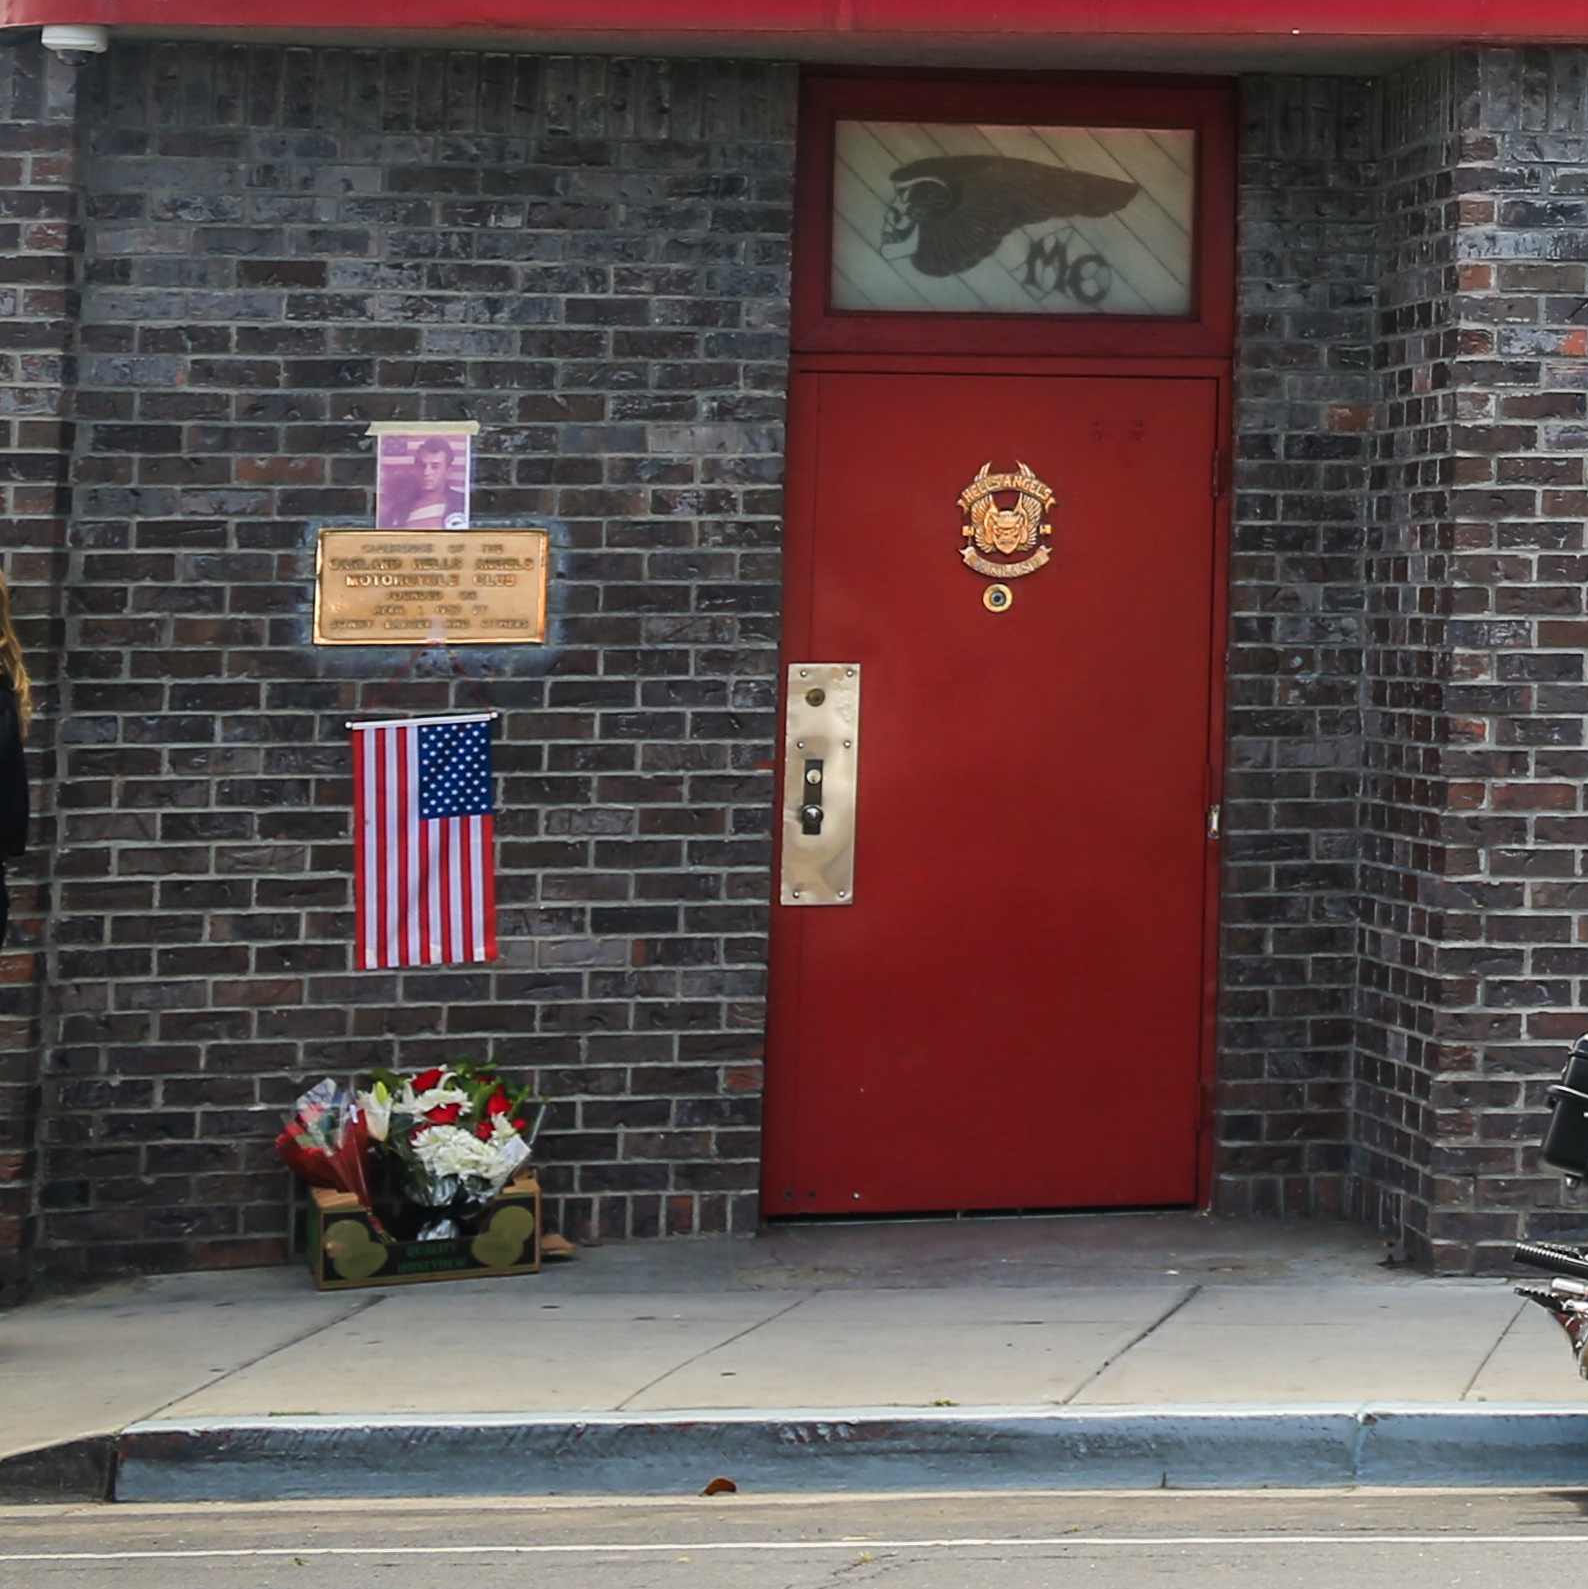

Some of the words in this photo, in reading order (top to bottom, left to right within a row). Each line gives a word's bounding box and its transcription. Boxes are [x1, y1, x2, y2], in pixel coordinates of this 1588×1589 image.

[1021, 234, 1113, 305] MC
[961, 478, 1001, 503] HELLS
[1004, 475, 1053, 500] ANGELS
[344, 574, 460, 587] MOTORCYCLE
[473, 574, 517, 587] CLUB
